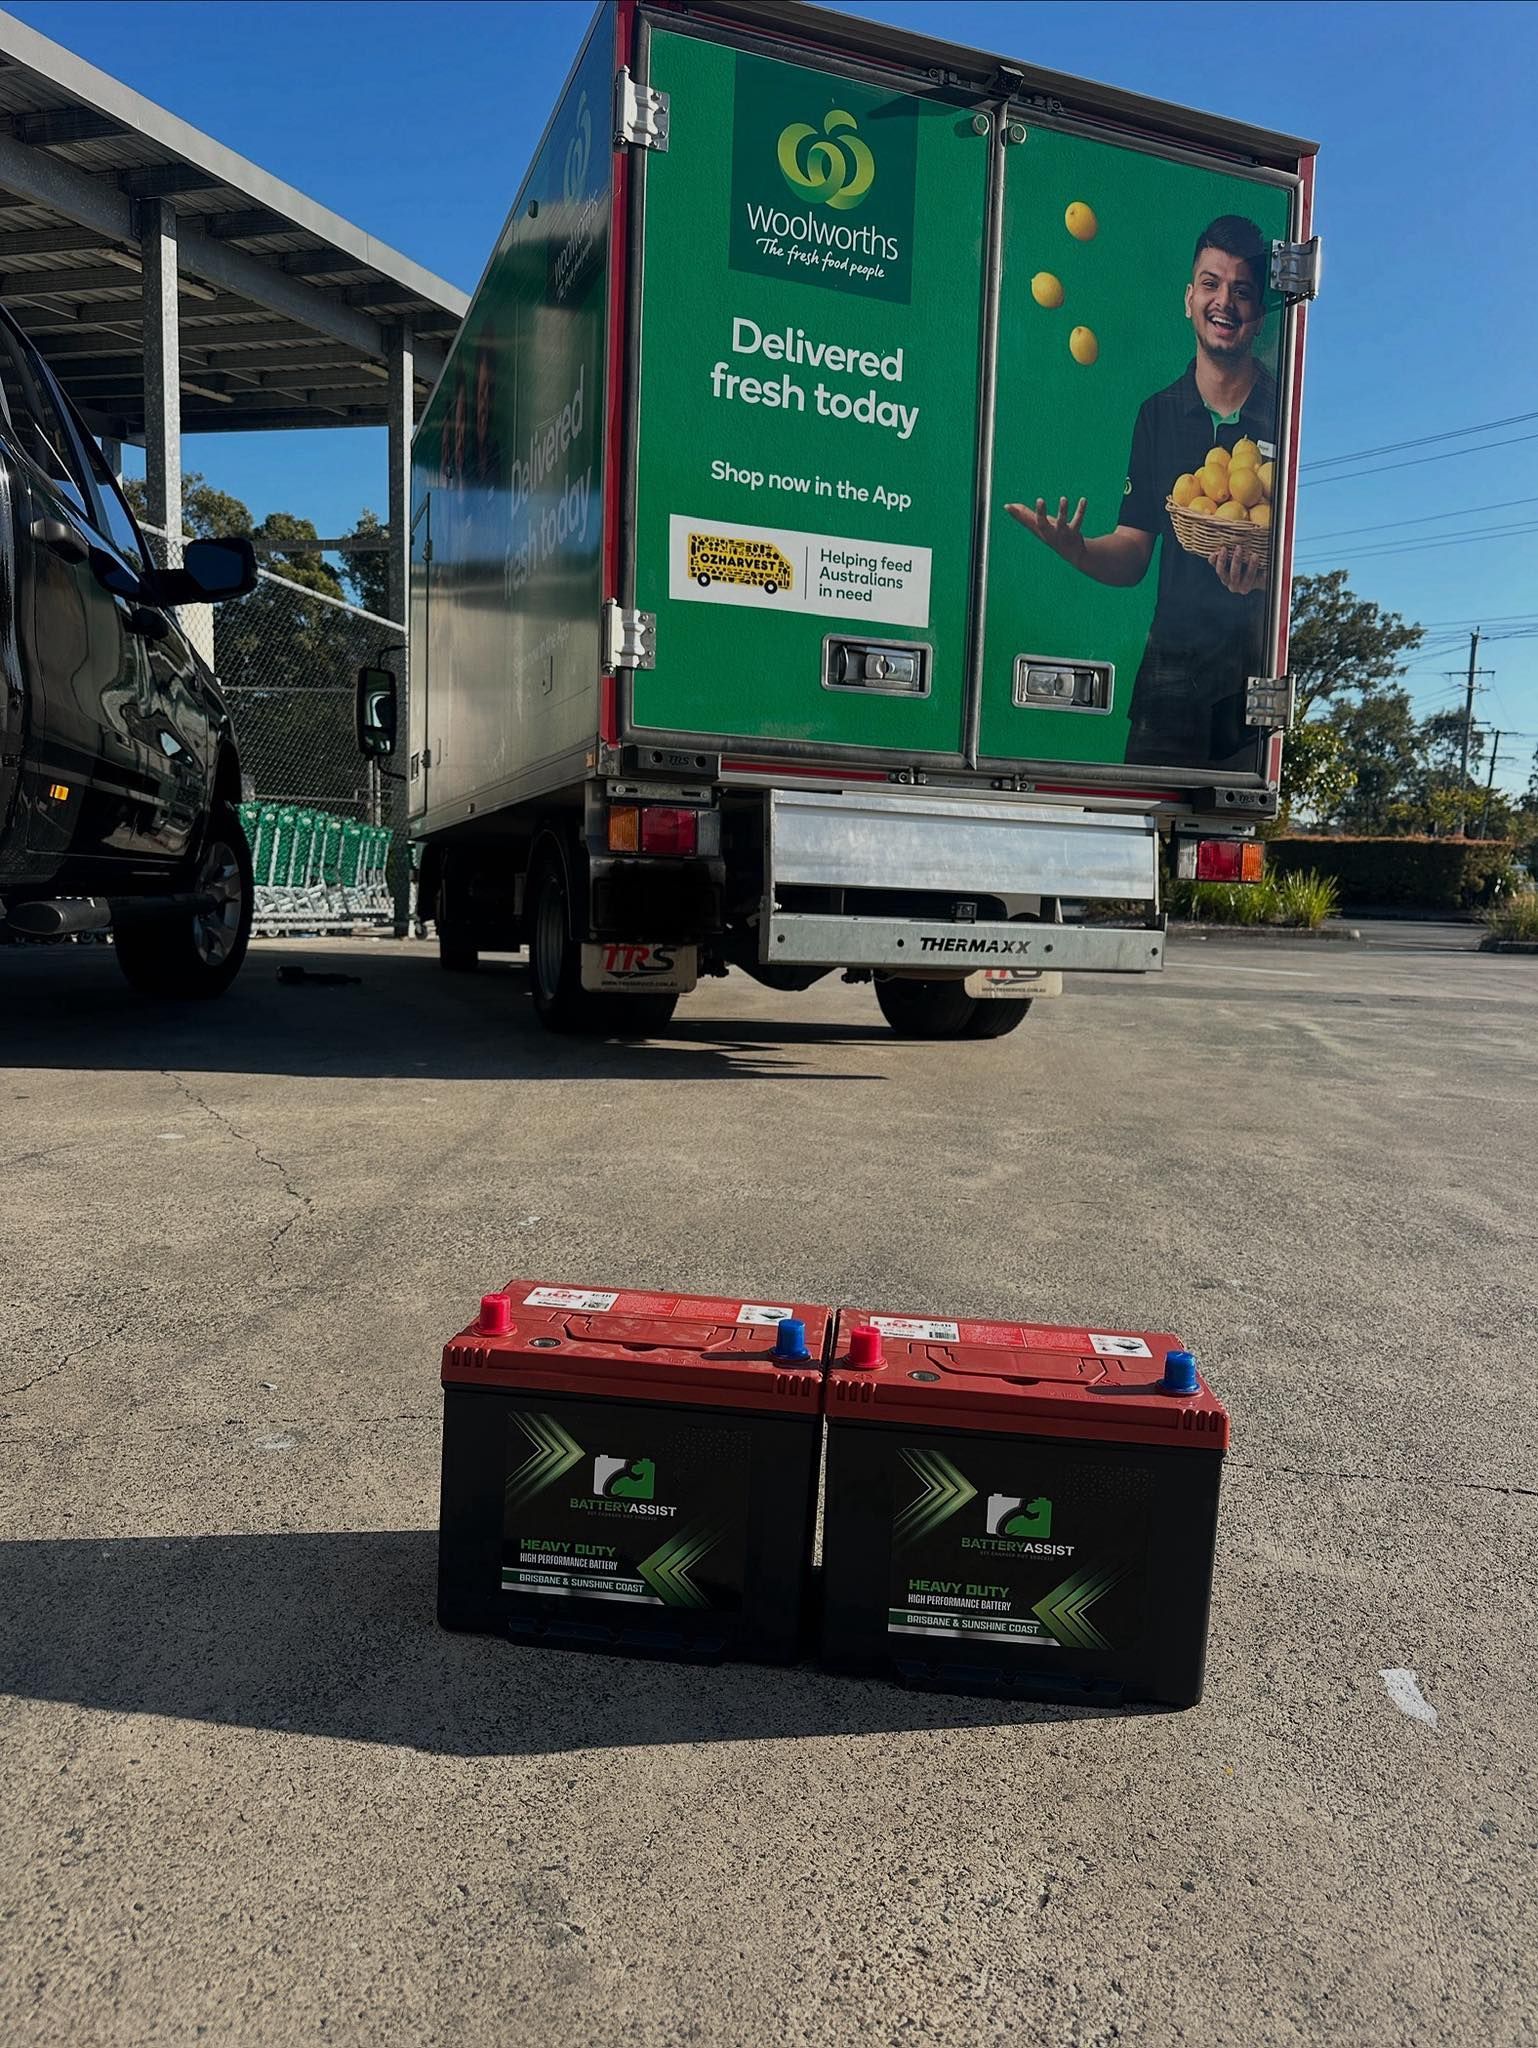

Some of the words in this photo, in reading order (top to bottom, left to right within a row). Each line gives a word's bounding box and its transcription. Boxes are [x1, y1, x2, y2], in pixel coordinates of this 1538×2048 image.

[747, 203, 899, 260] Woolworths
[756, 238, 784, 256] The
[787, 245, 819, 266] fresh
[821, 251, 849, 271] food
[849, 264, 885, 281] people
[732, 317, 904, 382] Delivered
[710, 362, 804, 411] fresh
[814, 383, 919, 439] today
[511, 363, 585, 520] Delivered
[711, 460, 764, 490] Shop
[769, 474, 811, 493] now
[815, 476, 832, 496] in
[837, 480, 869, 502] the
[872, 486, 912, 512] App
[541, 465, 592, 562] today
[700, 553, 777, 572] OZHARVEST
[820, 548, 877, 571] Helping
[881, 556, 912, 573] feed
[819, 566, 904, 589] Australians
[819, 584, 833, 597] in
[836, 588, 872, 602] need
[920, 937, 1032, 954] THERMAXX
[602, 945, 676, 971] TRS
[569, 1497, 677, 1517] BATTERYASSIST
[520, 1539, 571, 1553] HEAVY
[575, 1543, 616, 1557] DUTY
[961, 1537, 1075, 1556] BATTERYASSIST
[520, 1553, 537, 1563] HIGH
[538, 1554, 588, 1568] PERFORMANCE
[589, 1560, 618, 1571] BATTERY
[519, 1573, 561, 1585] BRISBANE
[571, 1578, 614, 1590] SUNSHINE
[616, 1582, 644, 1593] COAST
[909, 1579, 961, 1594] HEAVY
[966, 1584, 1010, 1598] DUTY
[908, 1593, 926, 1604] HIGH
[927, 1595, 979, 1609] PERFORMANCE
[981, 1600, 1011, 1611] BATTERY
[907, 1615, 950, 1627] BRISBANE
[952, 1619, 959, 1627] &
[962, 1619, 1006, 1632] SUNSHINE
[1009, 1623, 1039, 1634] COAST
